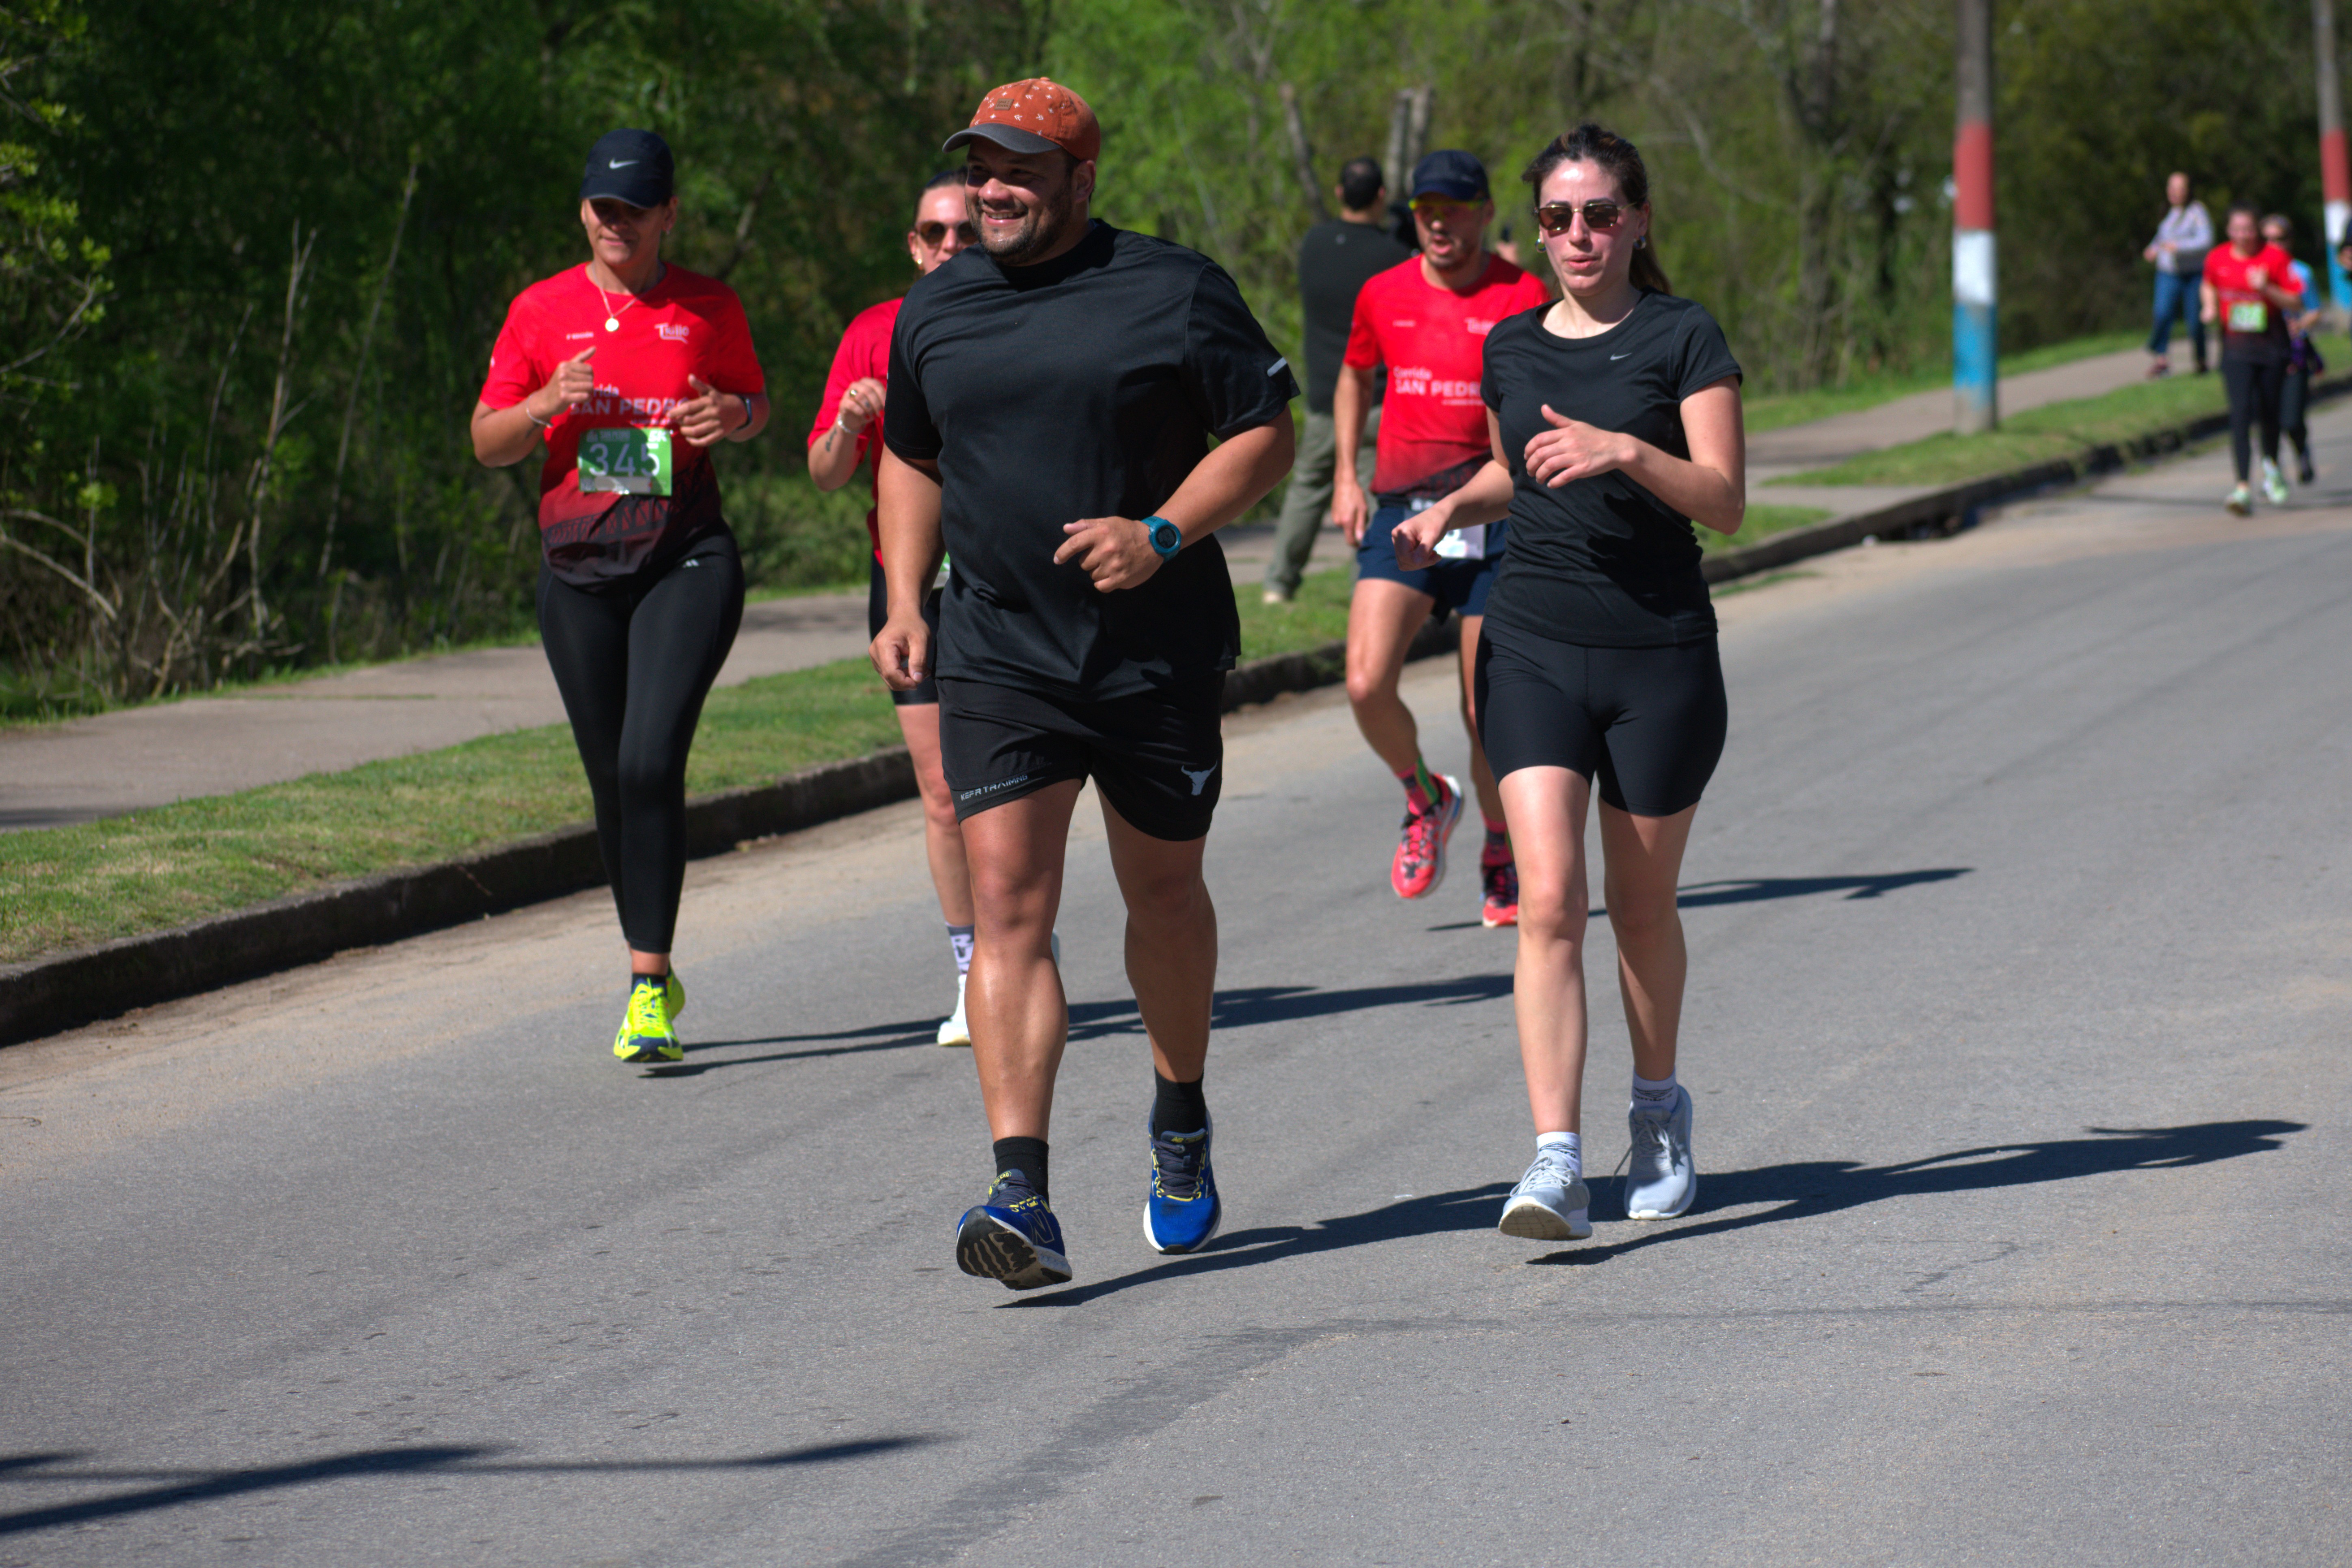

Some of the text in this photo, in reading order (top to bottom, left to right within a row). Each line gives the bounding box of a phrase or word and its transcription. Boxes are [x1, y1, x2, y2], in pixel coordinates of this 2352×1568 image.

[593, 384, 620, 397] rida
[1395, 378, 1426, 396] SAN
[570, 397, 689, 415] SAN PEDR
[589, 443, 660, 477] 345
